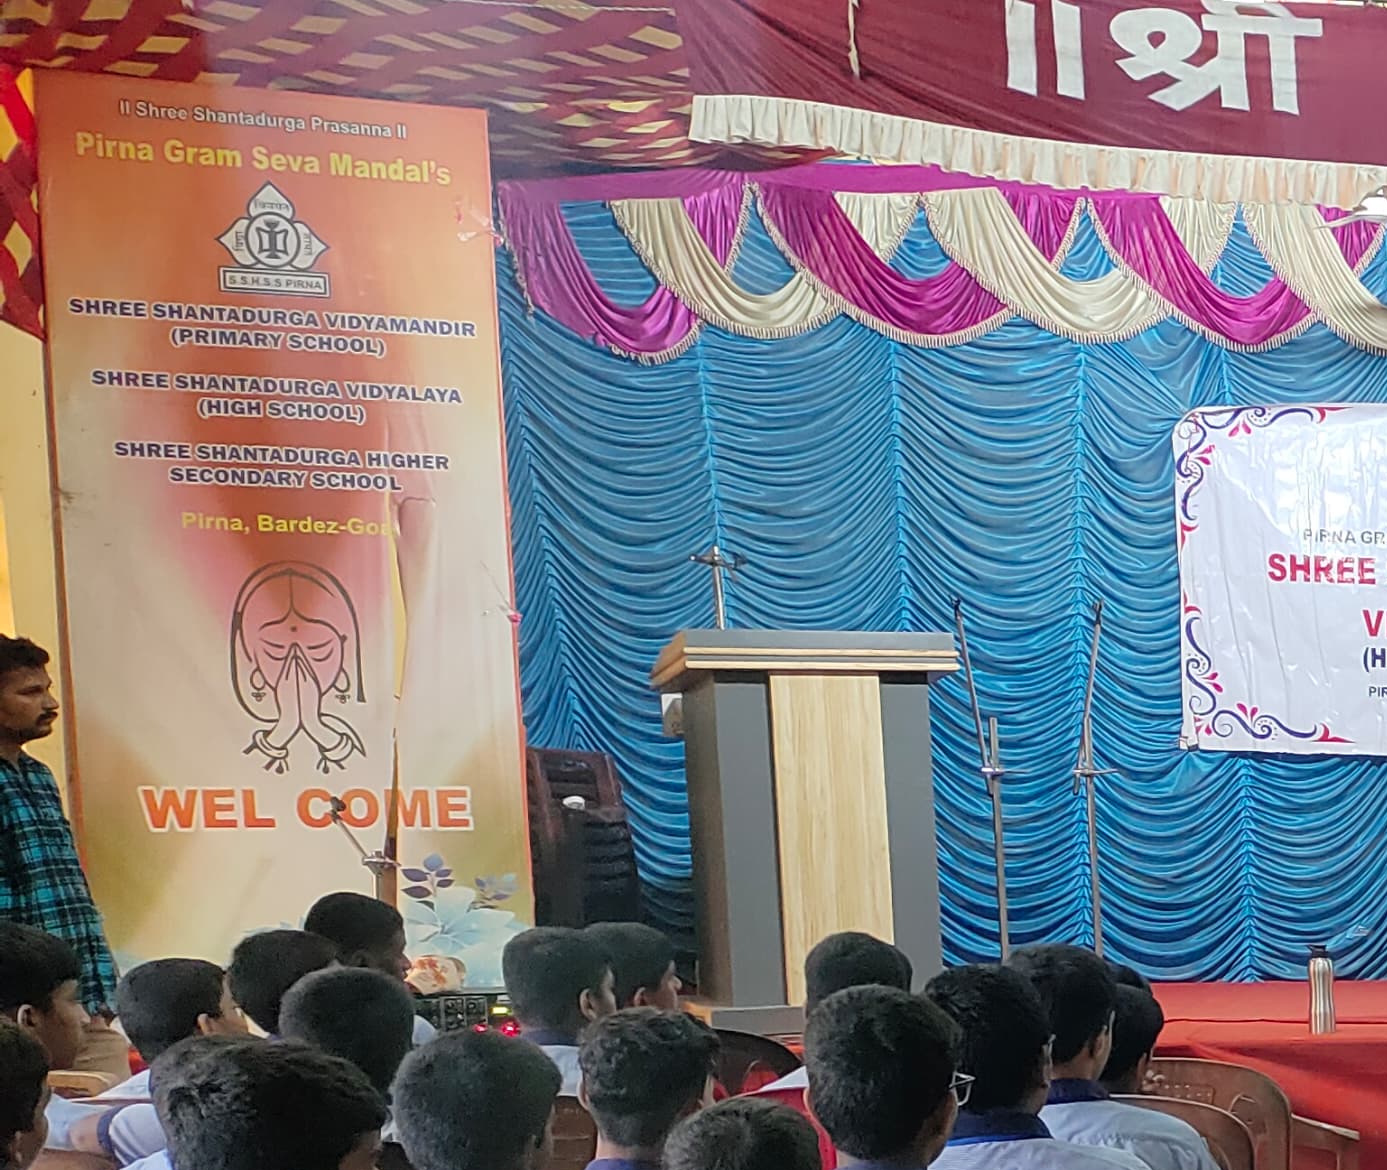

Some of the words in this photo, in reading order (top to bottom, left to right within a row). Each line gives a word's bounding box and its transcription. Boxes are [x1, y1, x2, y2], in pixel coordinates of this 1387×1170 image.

[136, 102, 188, 120] Shree
[193, 107, 305, 132] Shantadurga
[311, 116, 392, 137] Prasanna
[75, 132, 154, 161] Pirna
[164, 139, 242, 168] Gram
[253, 146, 320, 174] Seva
[329, 153, 452, 186] Mandal's
[285, 280, 323, 290] PIRNA
[69, 298, 148, 318] SHREE
[152, 304, 319, 329] SHANTADURGA
[325, 312, 477, 337] VIDYAMANDIR
[171, 327, 283, 349] (PRIMARY
[288, 334, 386, 358] SCHOOL)
[92, 370, 169, 389] SHREE
[175, 374, 340, 399] SHANTADURGA
[346, 382, 462, 404] VIDYALAYA
[198, 397, 263, 418] (HIGH
[267, 401, 366, 424] SCHOOL)
[114, 442, 190, 459] SHREE
[196, 445, 360, 468] SHANTADURGA
[366, 452, 449, 470] HIGHER
[170, 467, 305, 488] SECONDARY
[311, 471, 402, 491] SCHOOL
[182, 512, 249, 533] Pirna,
[1303, 528, 1356, 544] PIRNA
[1268, 553, 1376, 585] SHREE
[141, 788, 276, 830] WEL
[296, 788, 474, 831] COME
